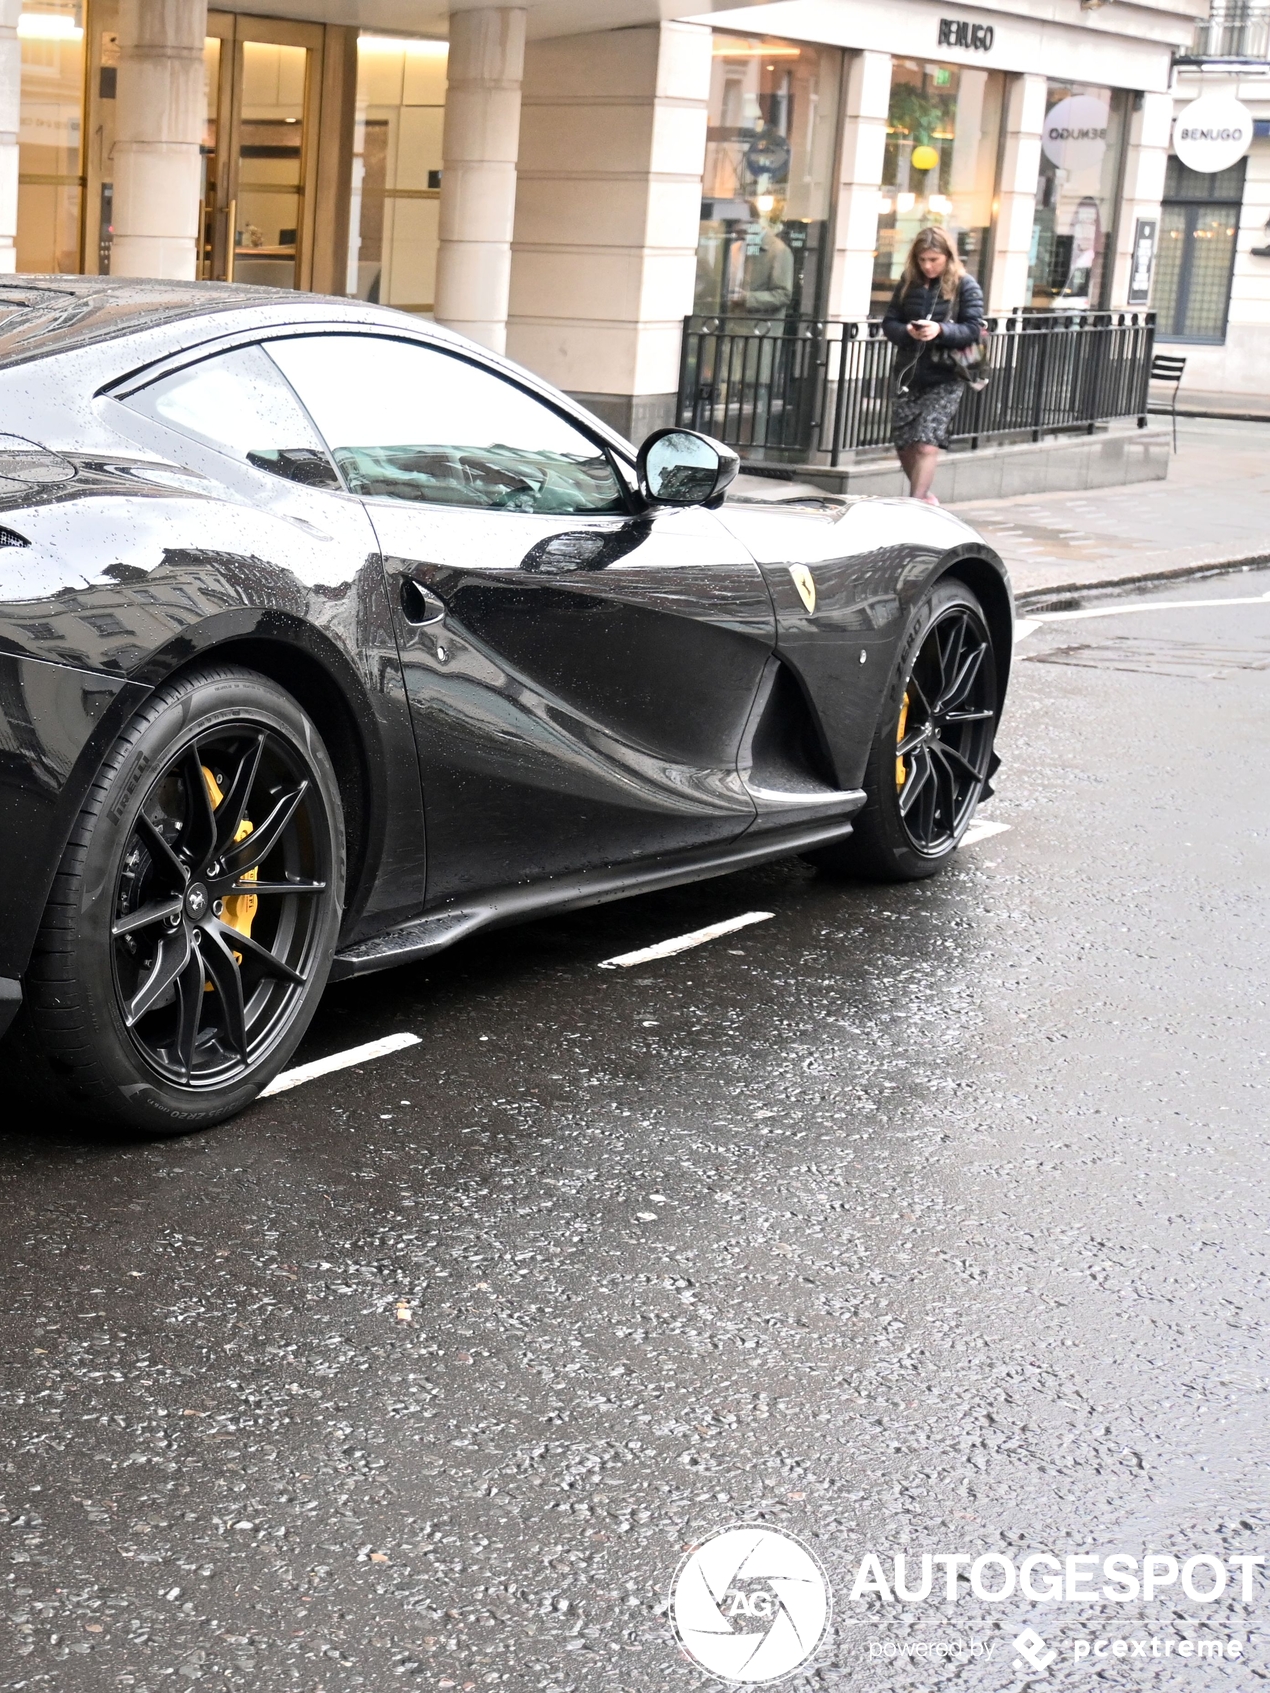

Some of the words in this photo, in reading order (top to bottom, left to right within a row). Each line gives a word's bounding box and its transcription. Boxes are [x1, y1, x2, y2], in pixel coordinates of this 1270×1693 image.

[938, 18, 994, 51] BENUGO
[1181, 128, 1243, 141] BENUGO
[106, 750, 150, 826] PIRELLI
[170, 1110, 207, 1120] ZR20
